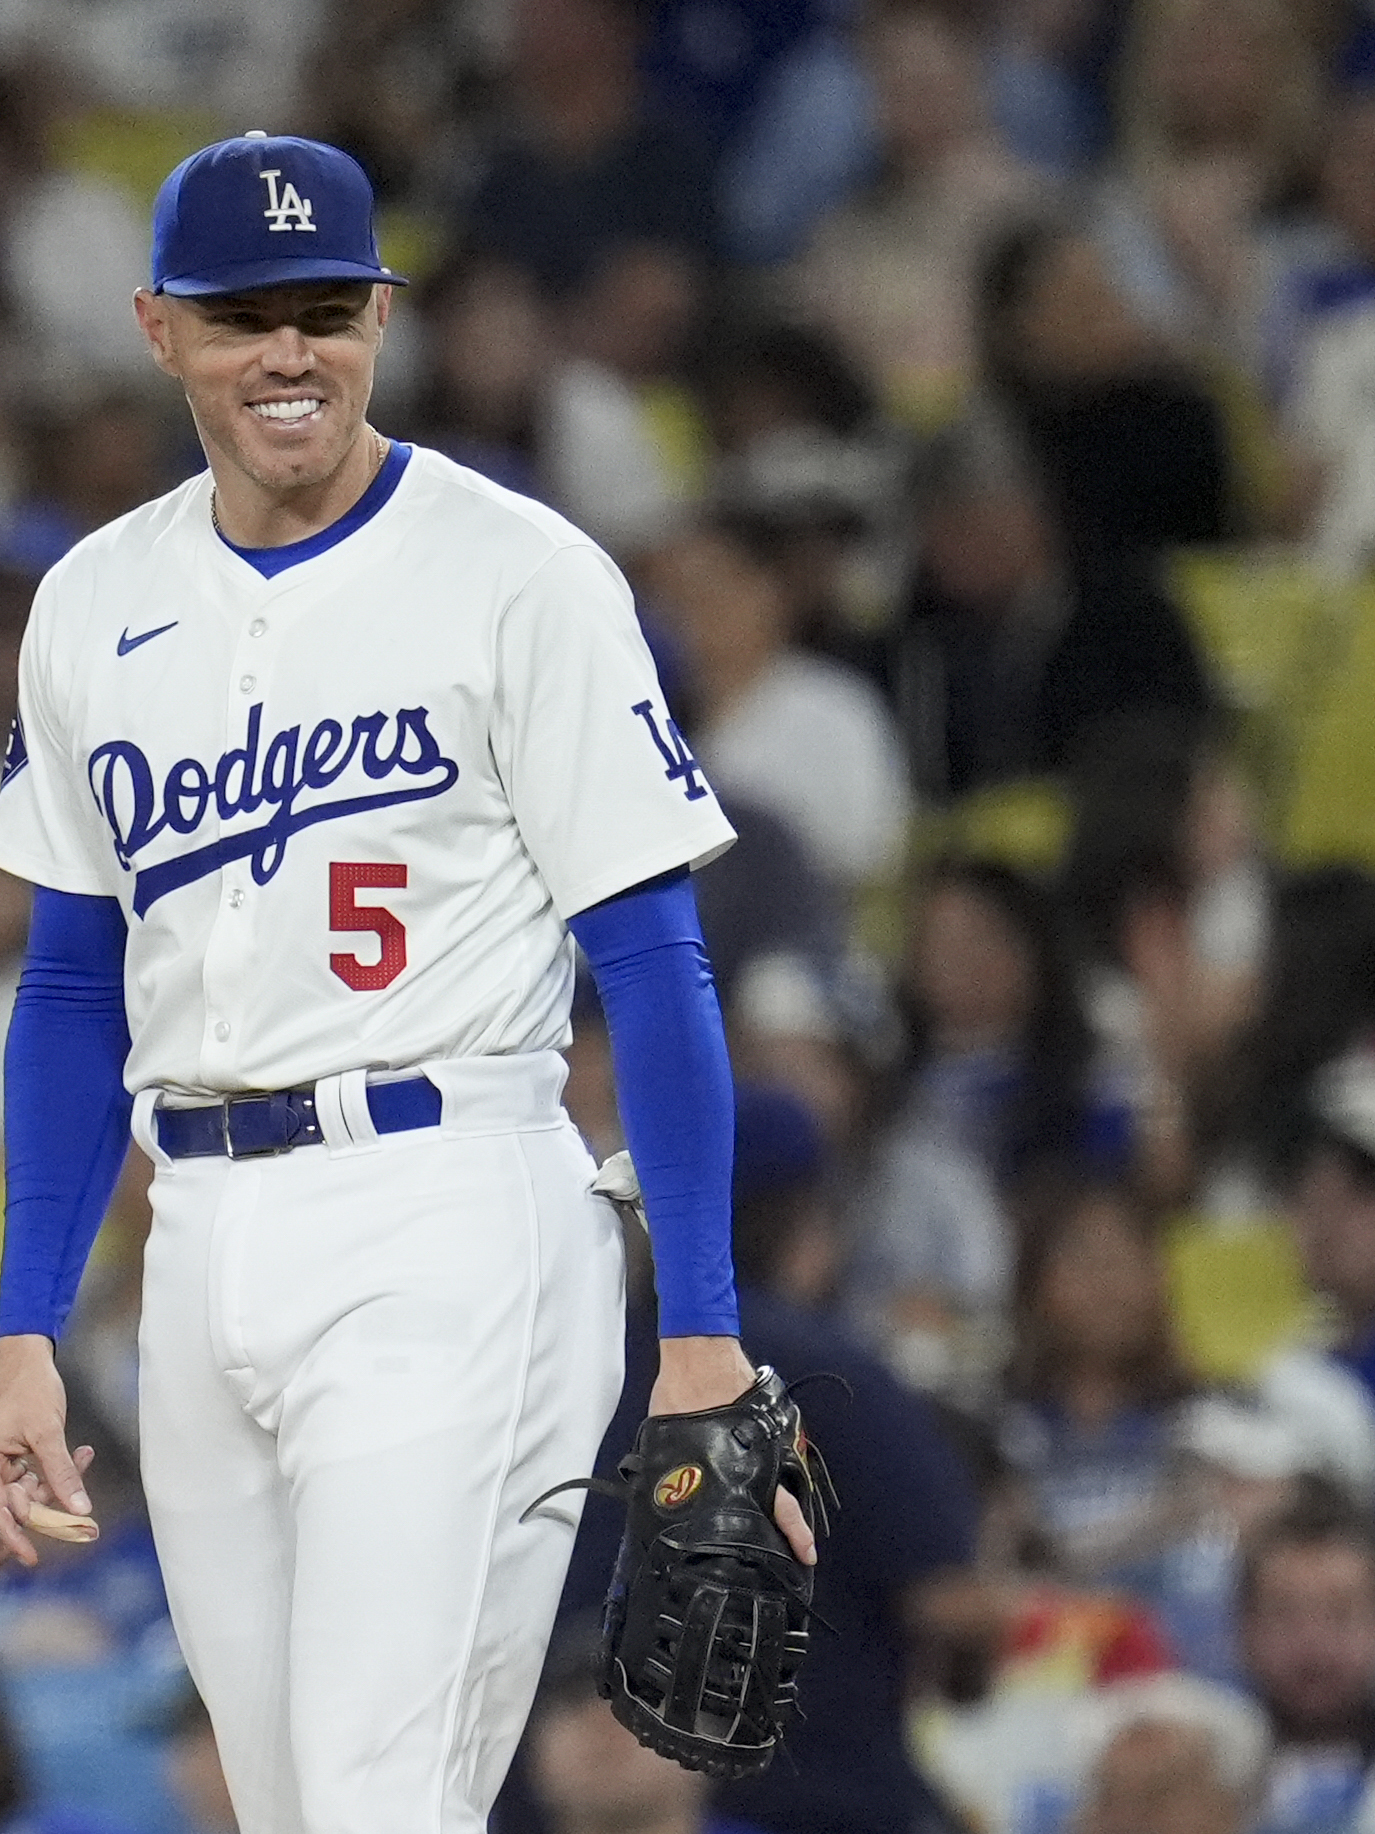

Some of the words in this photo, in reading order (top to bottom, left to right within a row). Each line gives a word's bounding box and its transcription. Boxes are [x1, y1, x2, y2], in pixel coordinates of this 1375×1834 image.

[259, 169, 317, 231] LA
[88, 702, 459, 890] Dodgers
[329, 862, 408, 992] 5
